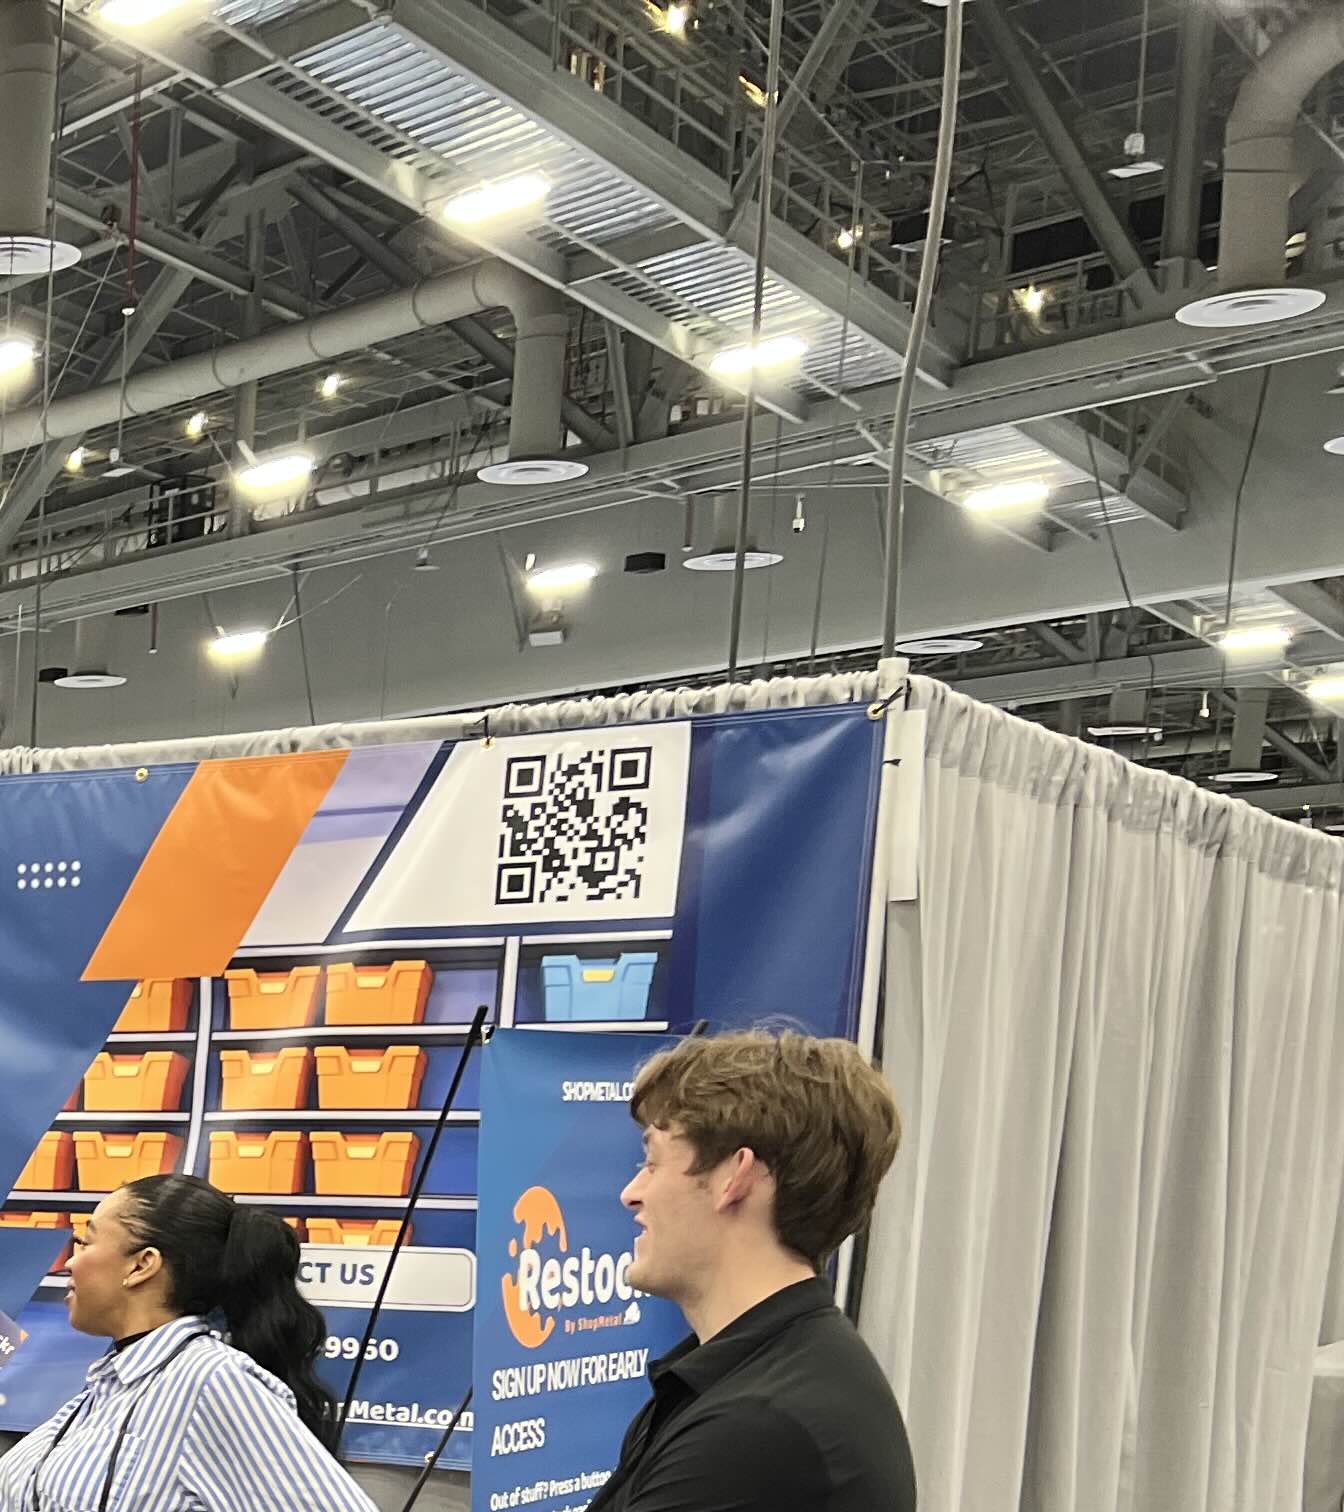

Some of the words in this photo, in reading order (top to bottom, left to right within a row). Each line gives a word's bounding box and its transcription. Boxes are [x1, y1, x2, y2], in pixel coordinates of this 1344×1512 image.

[340, 1263, 375, 1287] US
[518, 1246, 652, 1312] Restoc
[491, 1367, 526, 1401] SIGN
[525, 1363, 547, 1395] UP
[546, 1358, 583, 1392] NOW
[581, 1353, 609, 1387] FOR
[608, 1348, 650, 1382] EARLY
[490, 1416, 546, 1457] ACCESS
[489, 1491, 510, 1511] Out
[509, 1486, 522, 1507] of
[549, 1478, 574, 1498] Press
